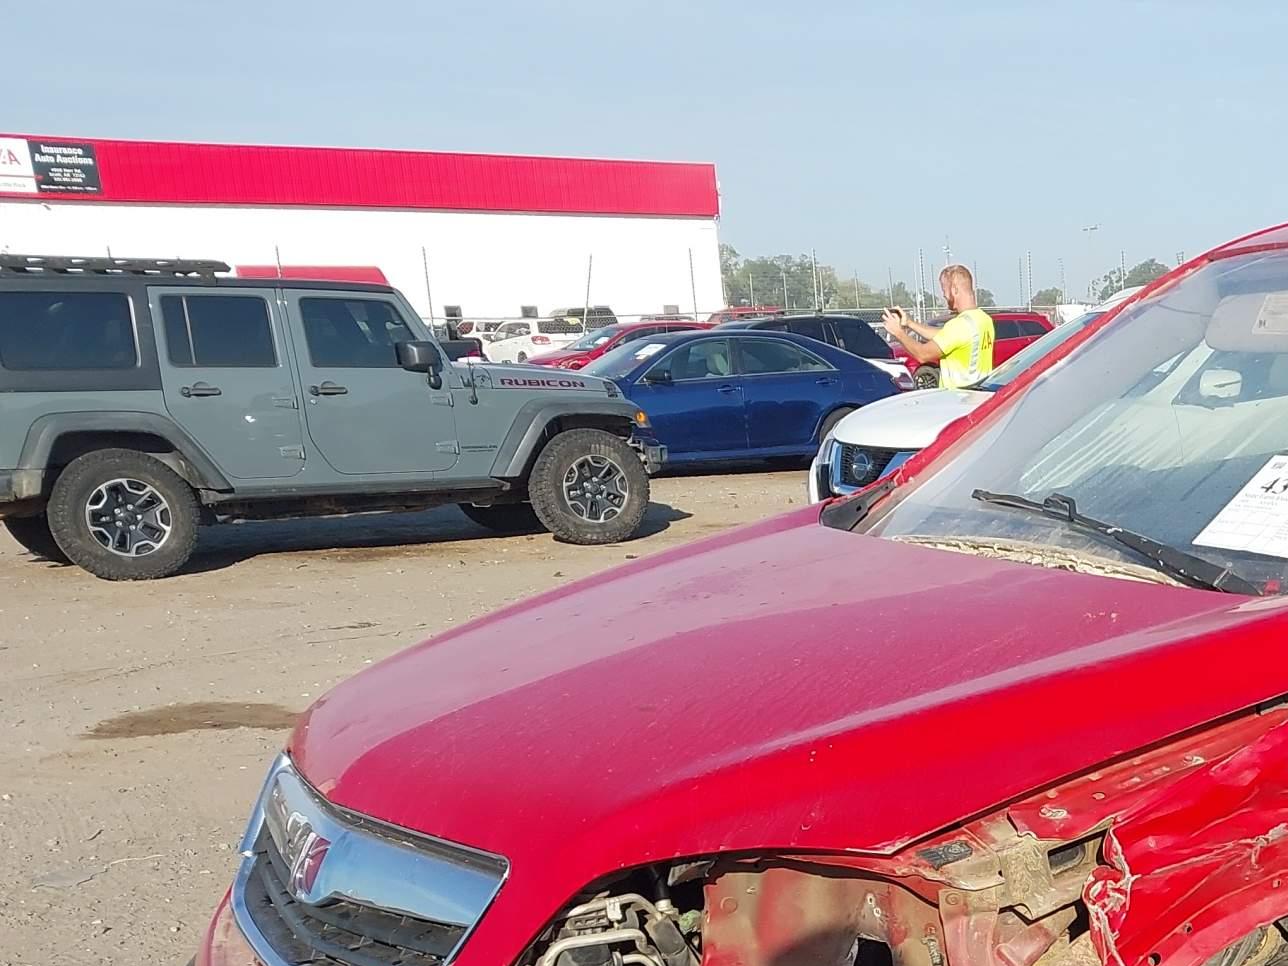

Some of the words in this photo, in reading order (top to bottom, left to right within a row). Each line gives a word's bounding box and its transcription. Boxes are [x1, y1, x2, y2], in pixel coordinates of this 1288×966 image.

[40, 144, 83, 155] Insurance
[34, 153, 55, 163] Auto
[56, 154, 93, 165] Auctions
[500, 378, 585, 388] RUBICON
